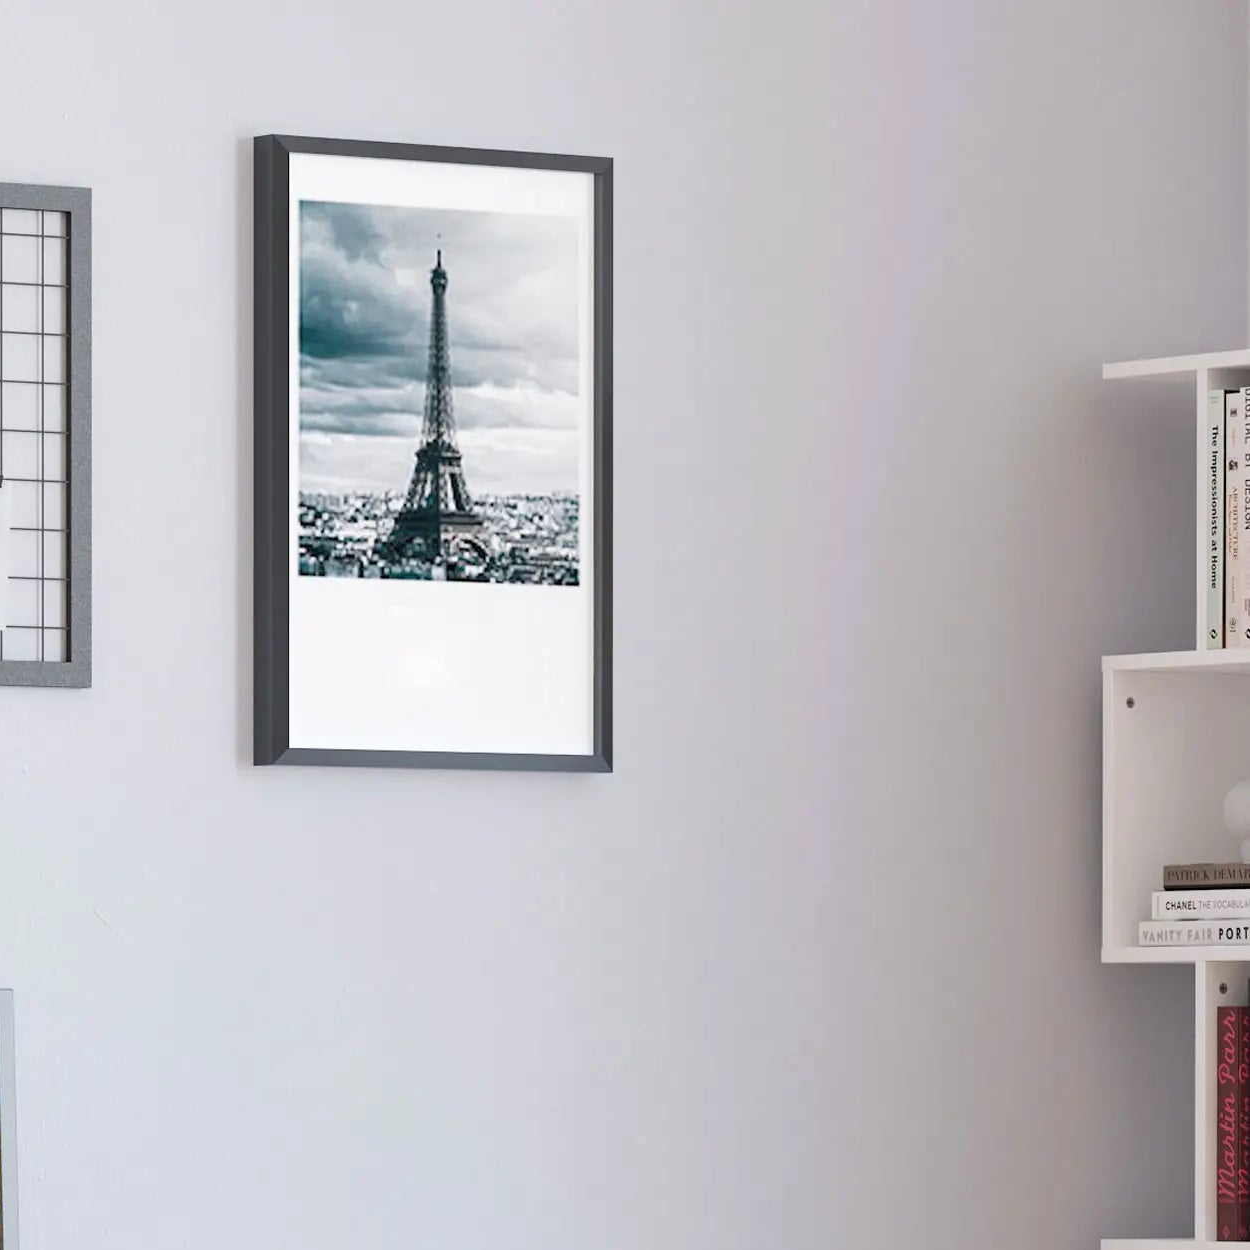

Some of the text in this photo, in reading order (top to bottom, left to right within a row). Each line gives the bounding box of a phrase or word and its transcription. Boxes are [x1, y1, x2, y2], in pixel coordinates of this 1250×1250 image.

[1210, 450, 1219, 536] Impressionists
[1211, 540, 1218, 552] at
[1167, 869, 1210, 881] PATRICK
[1165, 901, 1197, 911] CHANEL
[1213, 898, 1250, 909] VOCABULA
[1142, 926, 1250, 943] VANITY FAIR PORT
[1217, 1010, 1237, 1199] Martin Parr
